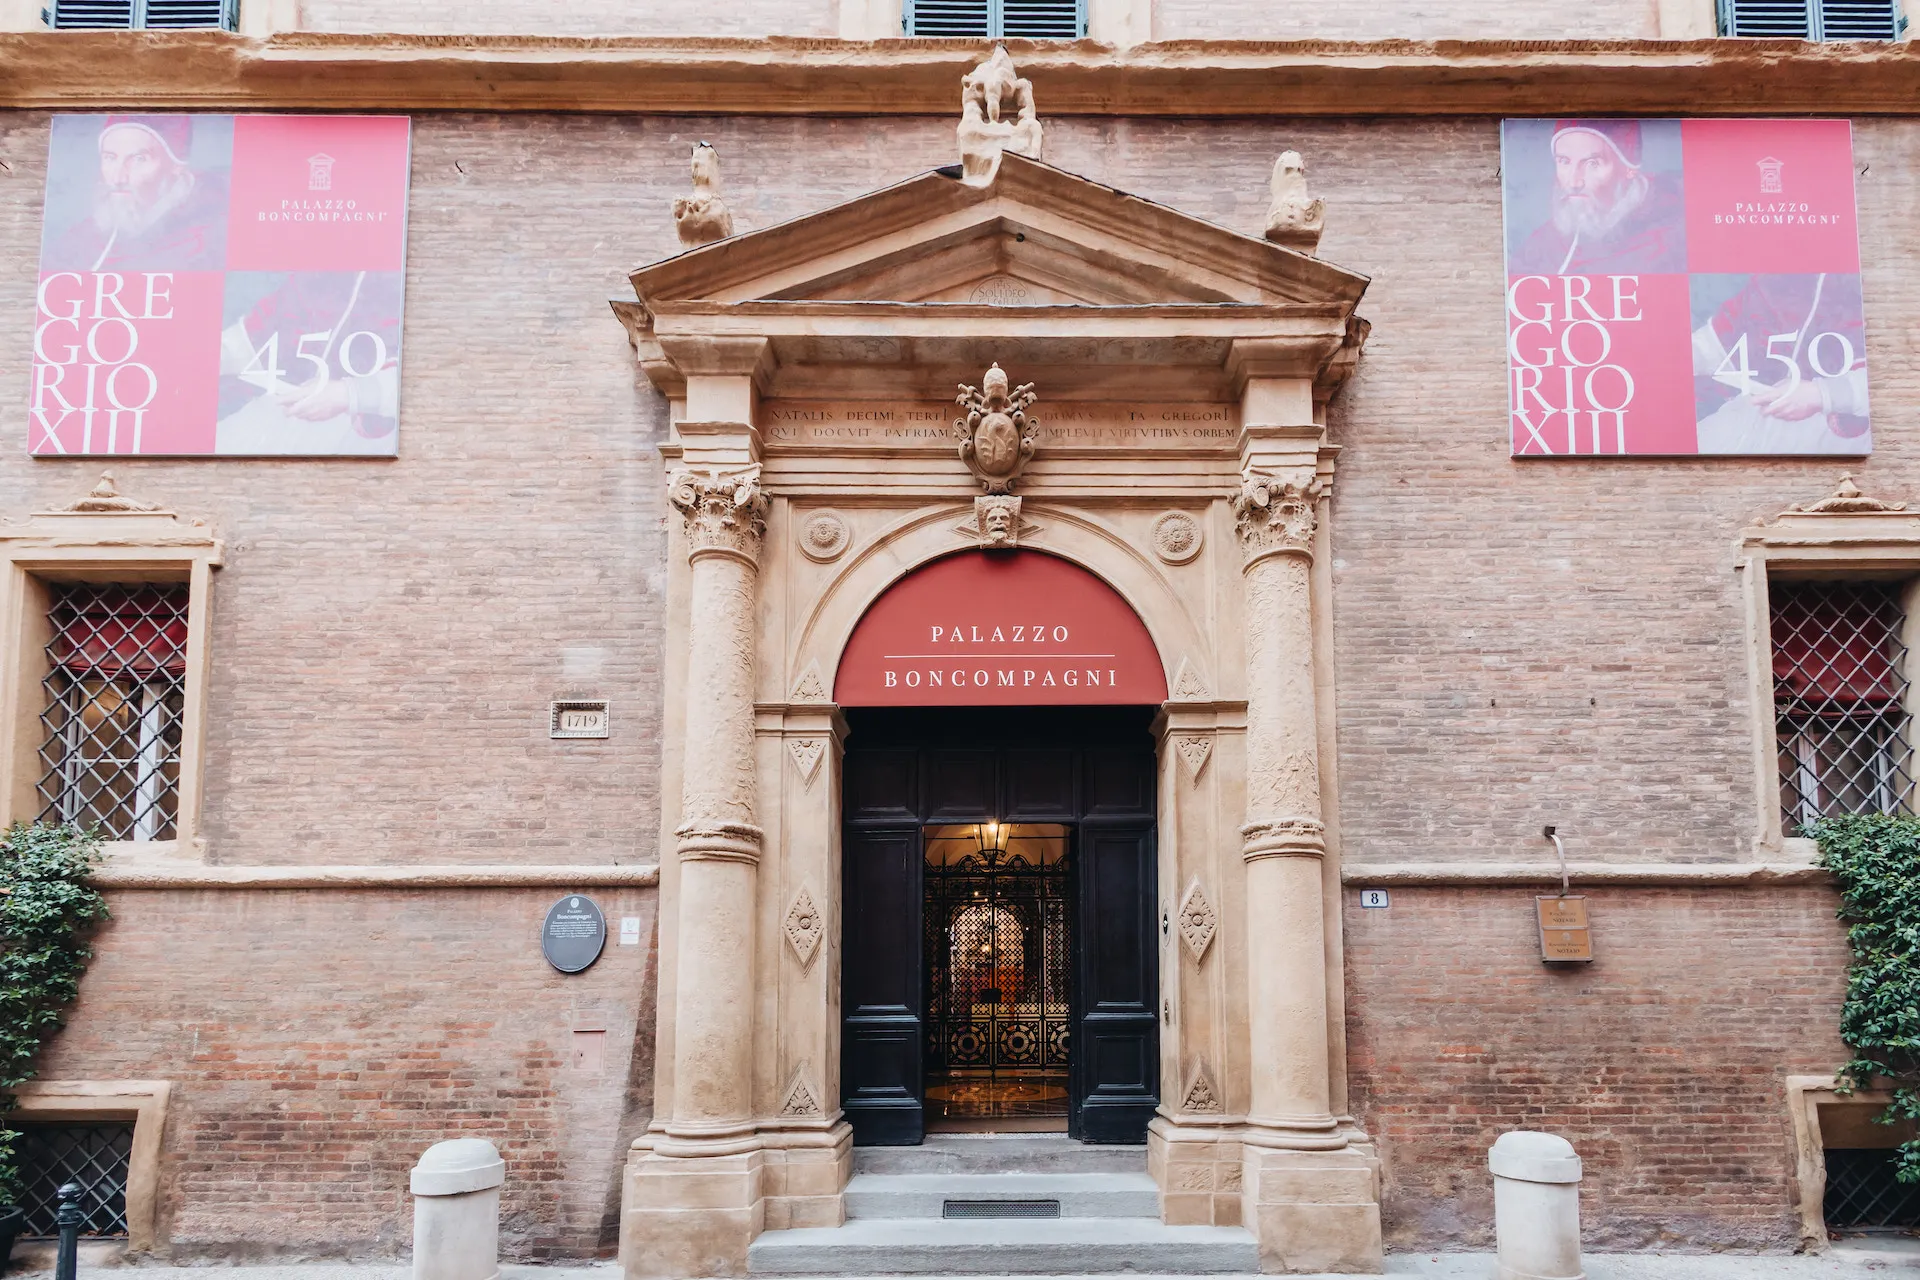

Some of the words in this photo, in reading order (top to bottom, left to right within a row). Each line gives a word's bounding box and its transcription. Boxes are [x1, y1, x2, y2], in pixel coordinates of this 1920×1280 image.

[281, 199, 357, 210] PALAZZO
[1735, 202, 1809, 213] PALAZZO
[37, 272, 174, 320] GRE
[1508, 275, 1643, 322] GRE
[34, 317, 138, 366] GO
[1510, 319, 1612, 368] GO
[31, 363, 158, 413] RIO
[238, 328, 388, 404] 450
[1713, 328, 1855, 411] 450
[1511, 364, 1635, 414] RIO
[29, 409, 149, 455] XIII
[770, 427, 797, 440] QVI
[814, 428, 870, 437] DOCVIT
[885, 428, 948, 438] PATRIAM
[1192, 428, 1235, 438] ORBEM
[771, 410, 833, 421] NATALIS
[846, 410, 894, 421] DECIMI
[1161, 408, 1229, 421] GREGORI
[1512, 410, 1630, 455] XIII
[931, 625, 1069, 643] PALAZZO
[884, 669, 1117, 687] BONCOMPAGNI
[568, 715, 598, 727] 1719
[1370, 892, 1379, 905] 8
